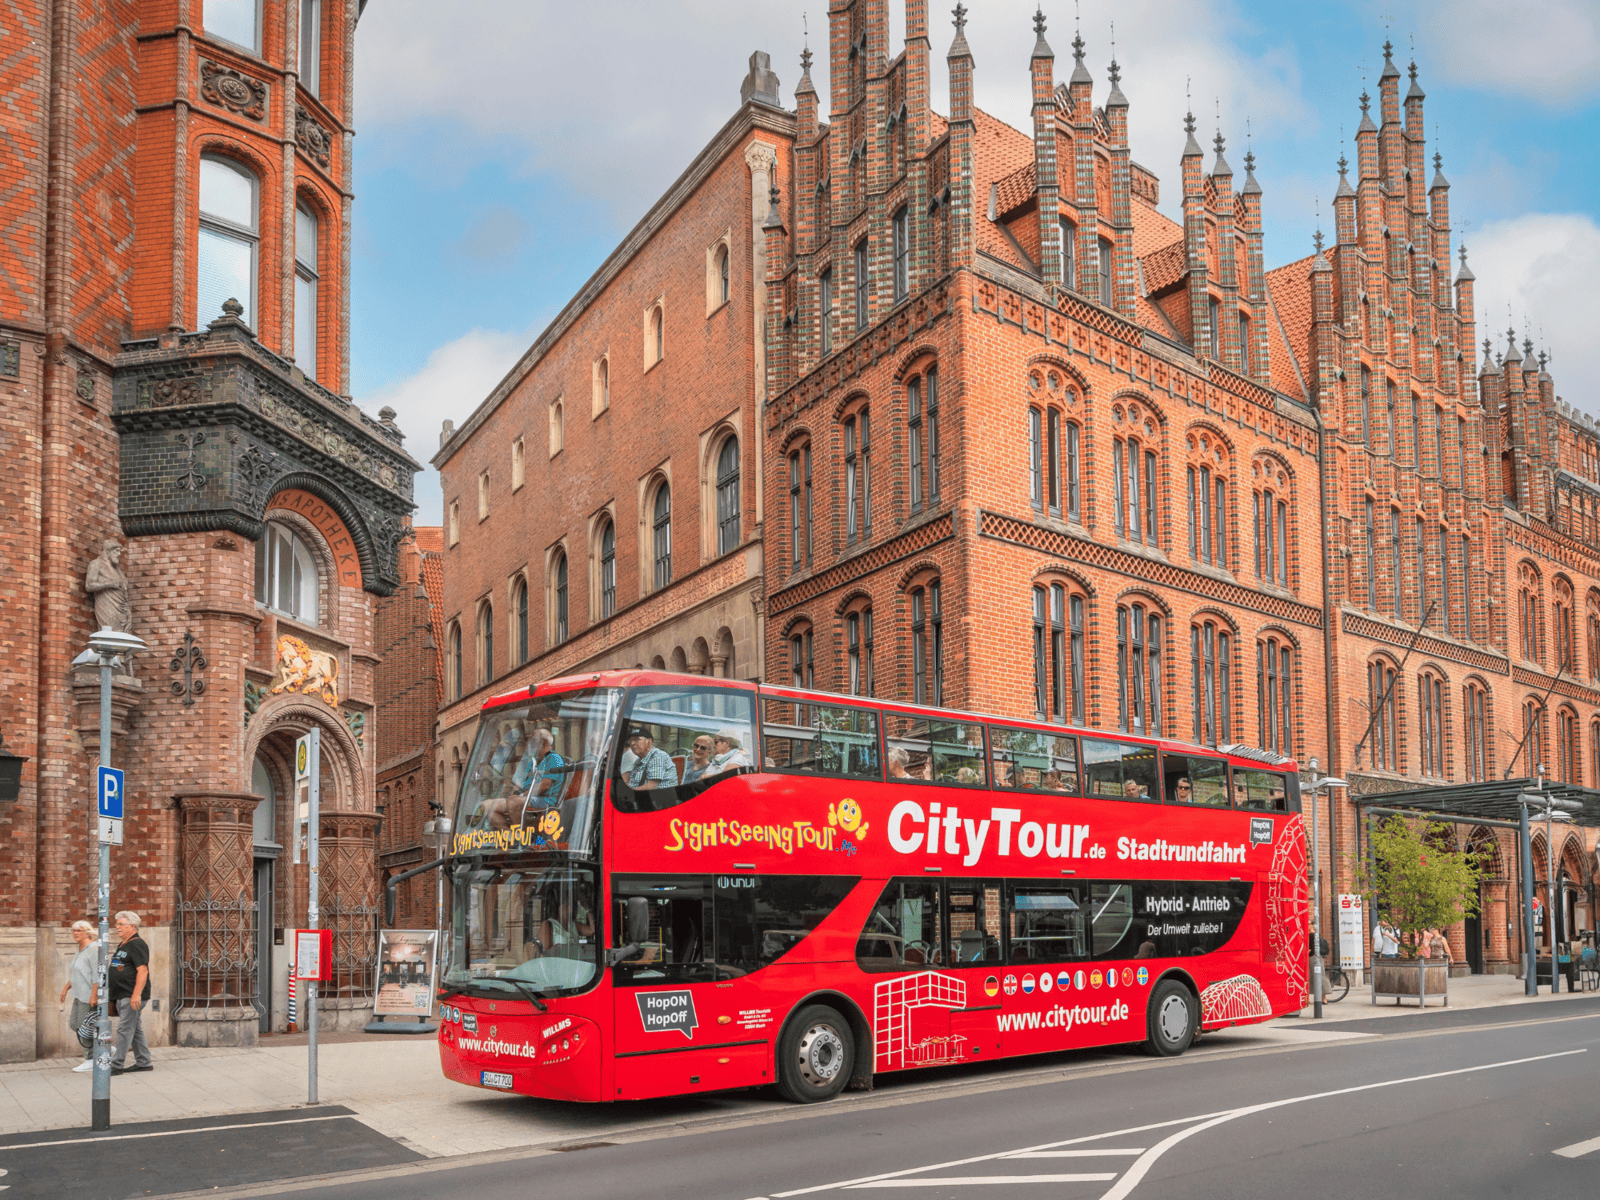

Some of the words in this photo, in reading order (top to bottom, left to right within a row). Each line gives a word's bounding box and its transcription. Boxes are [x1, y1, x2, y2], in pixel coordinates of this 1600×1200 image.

[104, 773, 119, 811] P
[887, 800, 1107, 867] CityTour.de
[1117, 837, 1246, 863] Stadtrundfahrt
[1146, 896, 1184, 915] Hybrid
[1192, 896, 1231, 912] Antrieb
[1147, 924, 1162, 936] Der
[1163, 923, 1191, 935] Umwelt
[647, 995, 688, 1010] HopON
[647, 1010, 688, 1027] HopOff
[997, 998, 1129, 1032] www.citytour.de
[542, 1018, 572, 1039] WILLMS
[458, 1037, 536, 1058] www.citytour.de
